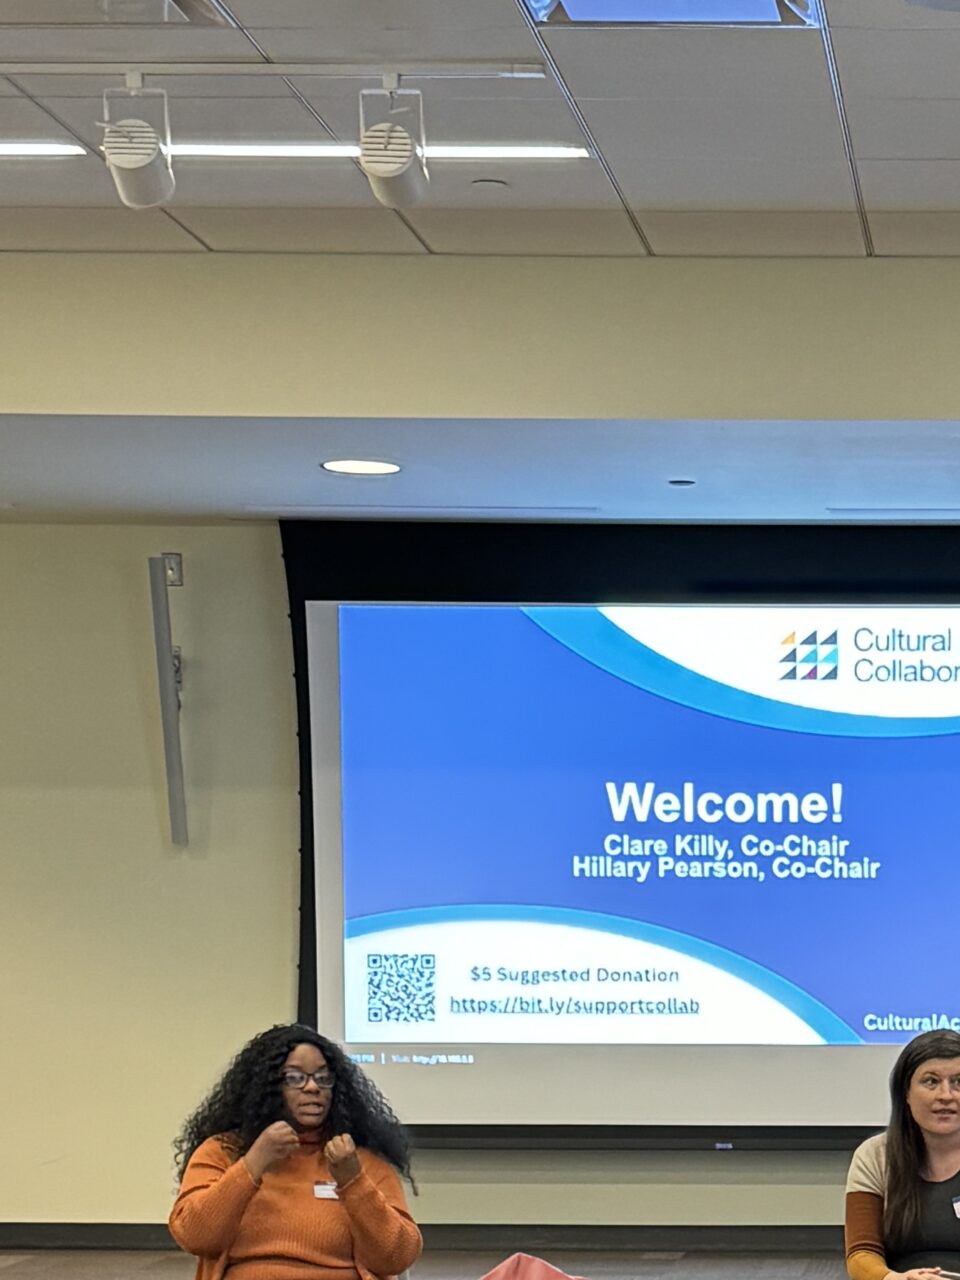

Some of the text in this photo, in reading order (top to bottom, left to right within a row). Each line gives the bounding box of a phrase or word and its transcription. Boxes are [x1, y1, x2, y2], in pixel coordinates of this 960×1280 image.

[854, 627, 952, 652] Cultural
[605, 781, 843, 824] Welcome!
[603, 834, 850, 860] Clare Killy, Co-Chair
[572, 856, 881, 882] Hillary Pearson, Co-Chair
[470, 965, 680, 985] $5 Suggested Donation
[449, 996, 700, 1015] https://bit.ly/supportcollab
